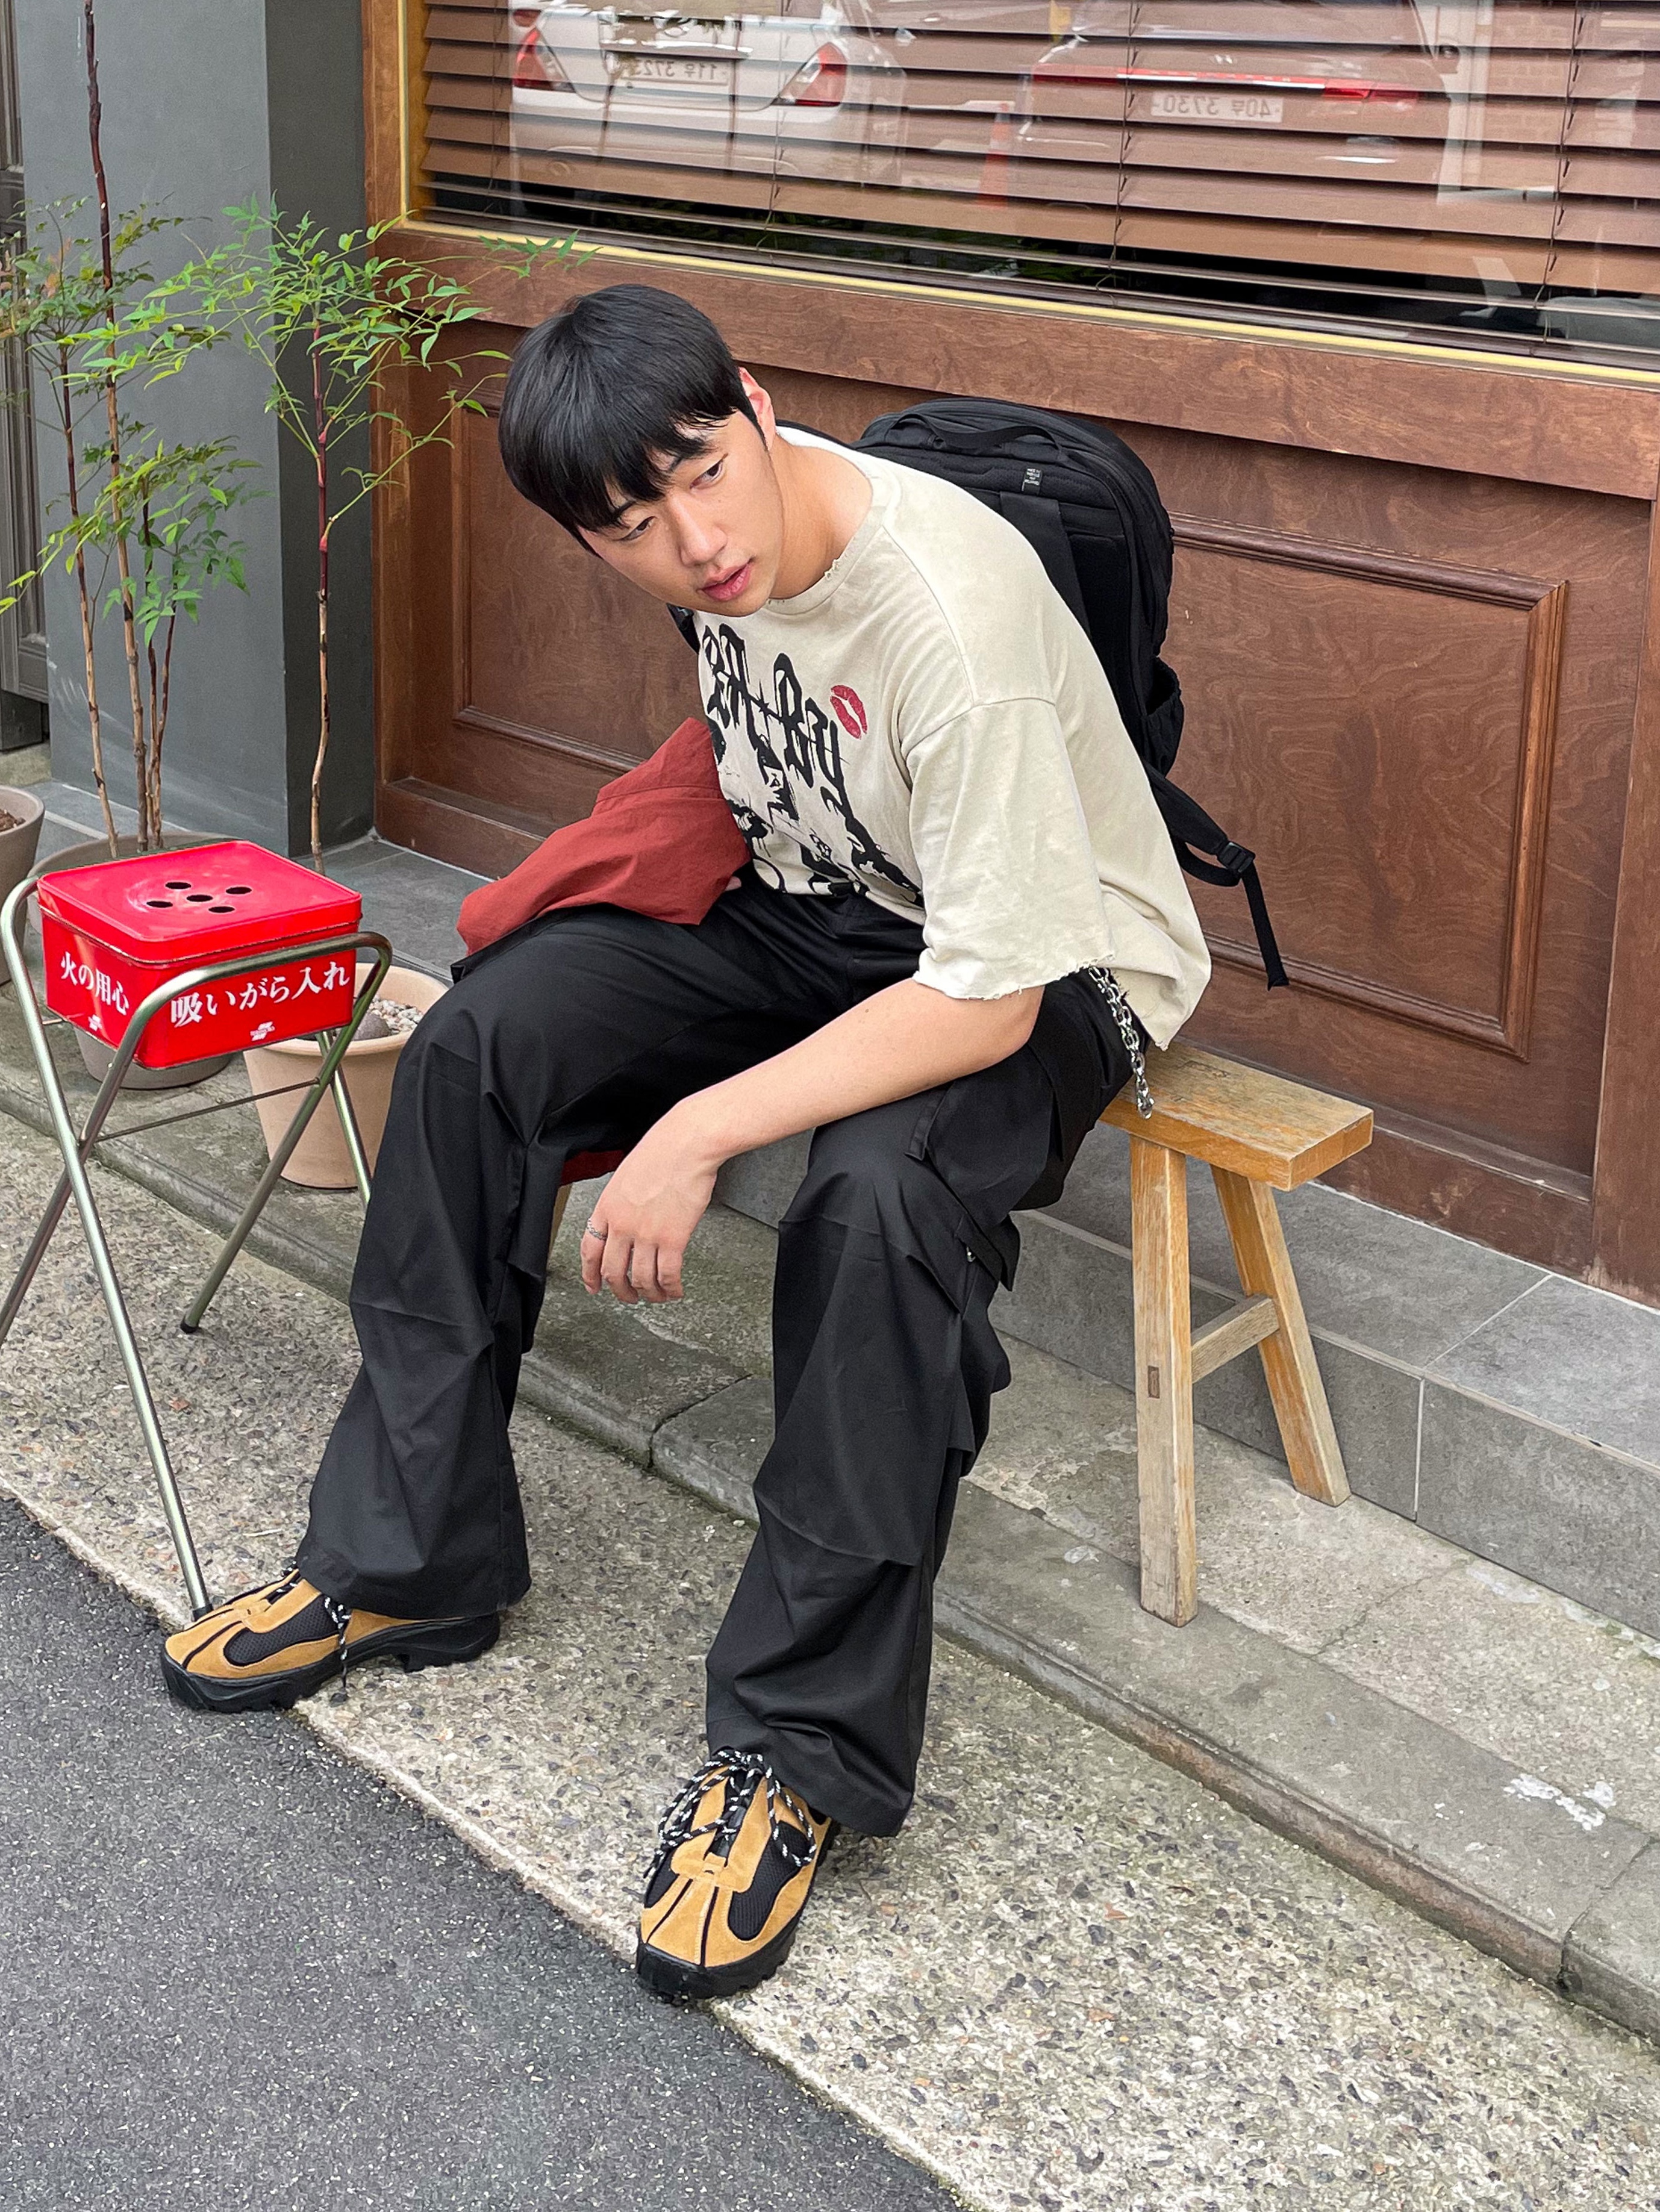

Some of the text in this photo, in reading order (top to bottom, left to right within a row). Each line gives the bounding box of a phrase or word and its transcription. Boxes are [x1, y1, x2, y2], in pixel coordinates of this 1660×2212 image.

[60, 951, 129, 1016] 火の用心
[170, 961, 350, 1028] 吸いがら入れ
